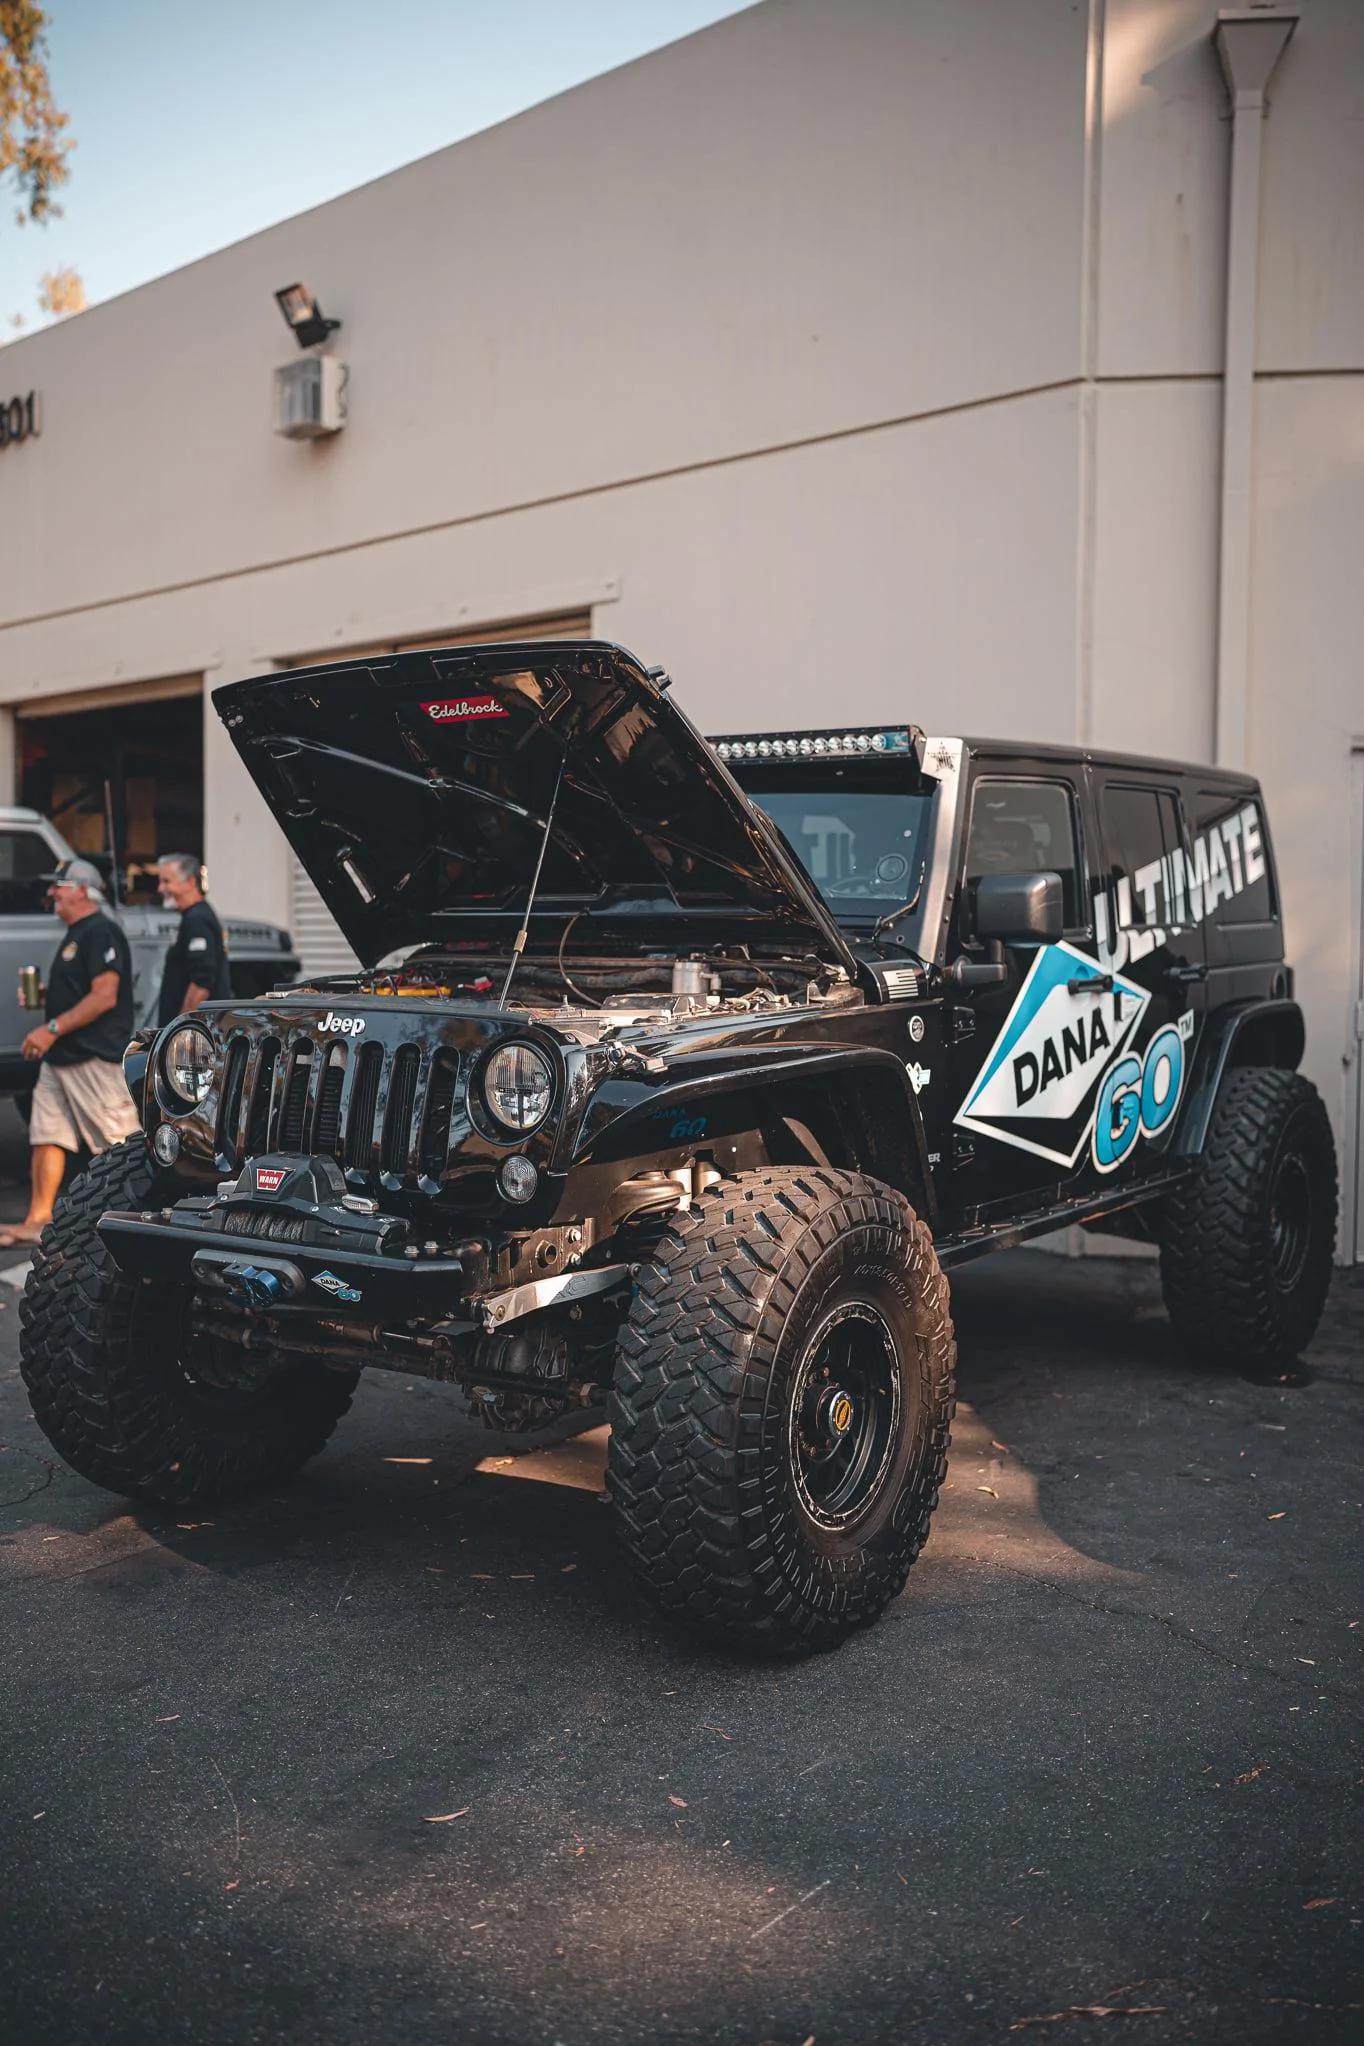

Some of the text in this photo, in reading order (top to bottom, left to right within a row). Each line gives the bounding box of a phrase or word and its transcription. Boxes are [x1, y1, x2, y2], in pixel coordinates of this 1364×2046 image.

[428, 699, 503, 719] Edelbrock
[1094, 801, 1265, 973] ULTIMATE
[317, 1011, 366, 1037] Jeep
[1013, 1007, 1112, 1108] DANA
[259, 1175, 279, 1185] WARN
[320, 1278, 341, 1287] DANA
